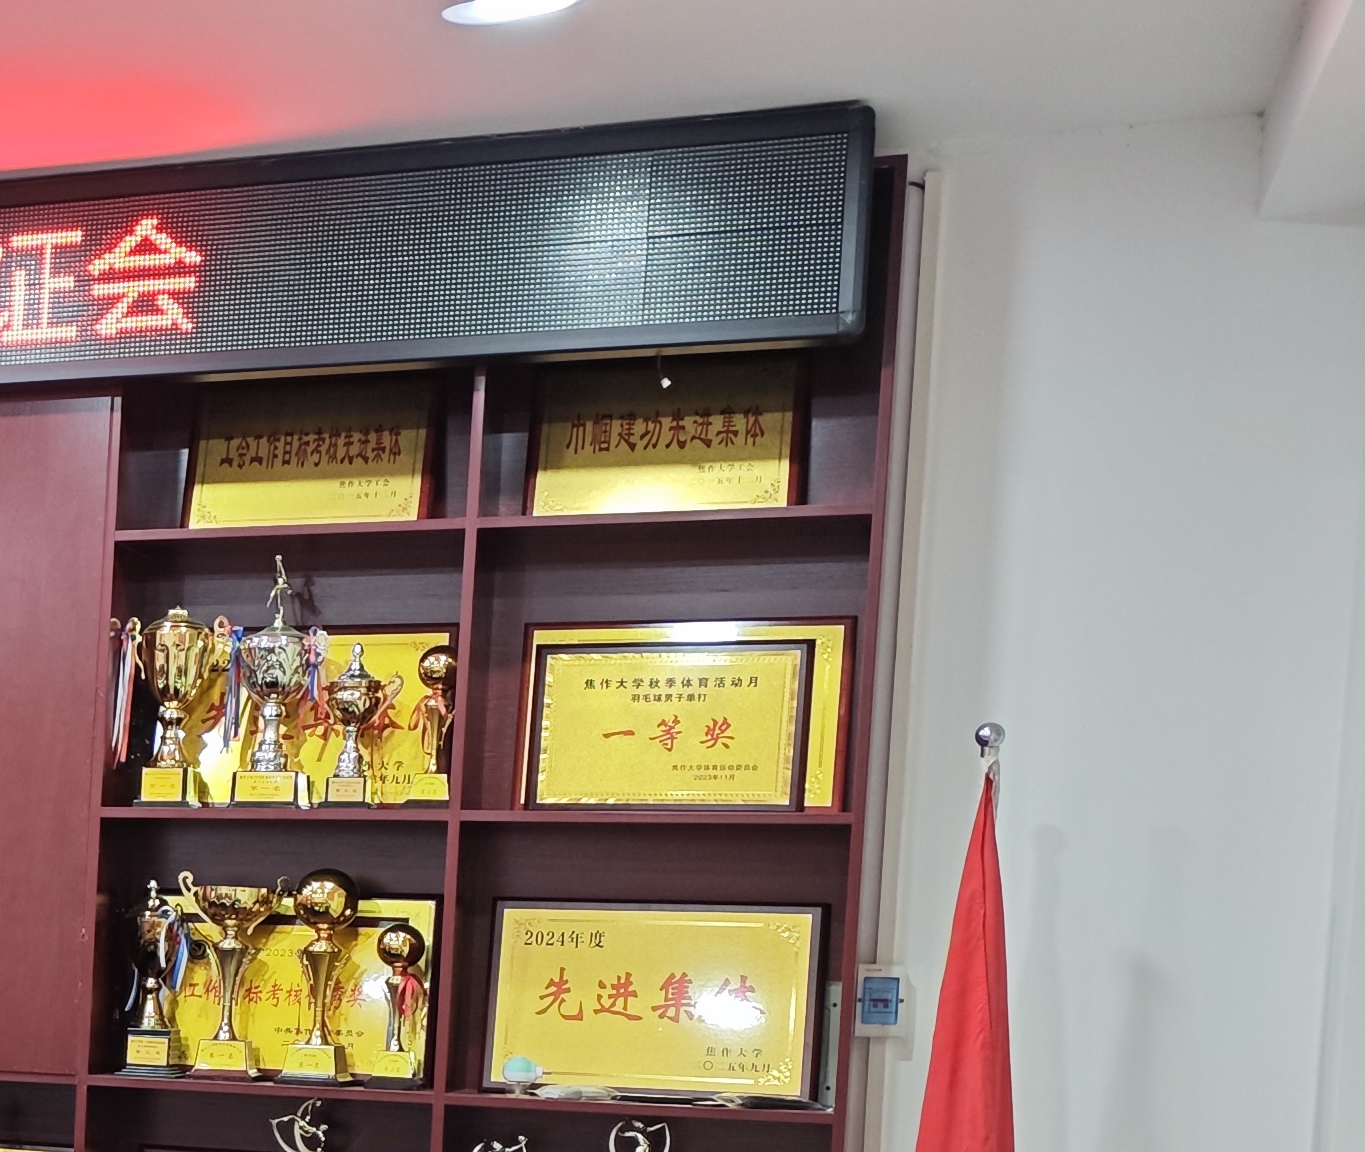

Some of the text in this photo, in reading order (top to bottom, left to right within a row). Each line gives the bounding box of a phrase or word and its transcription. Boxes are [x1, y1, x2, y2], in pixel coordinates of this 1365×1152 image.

[566, 404, 766, 455] 巾帼建功先进集体
[220, 424, 402, 469] 工会工作目标考核先进集体
[583, 676, 759, 690] 焦作大学秋季体育活动月
[630, 693, 708, 703] 羽毛球男子单打
[601, 714, 736, 753] 一等奖
[523, 929, 606, 949] 2024年度
[183, 978, 367, 1010] 工作标考核秀奖
